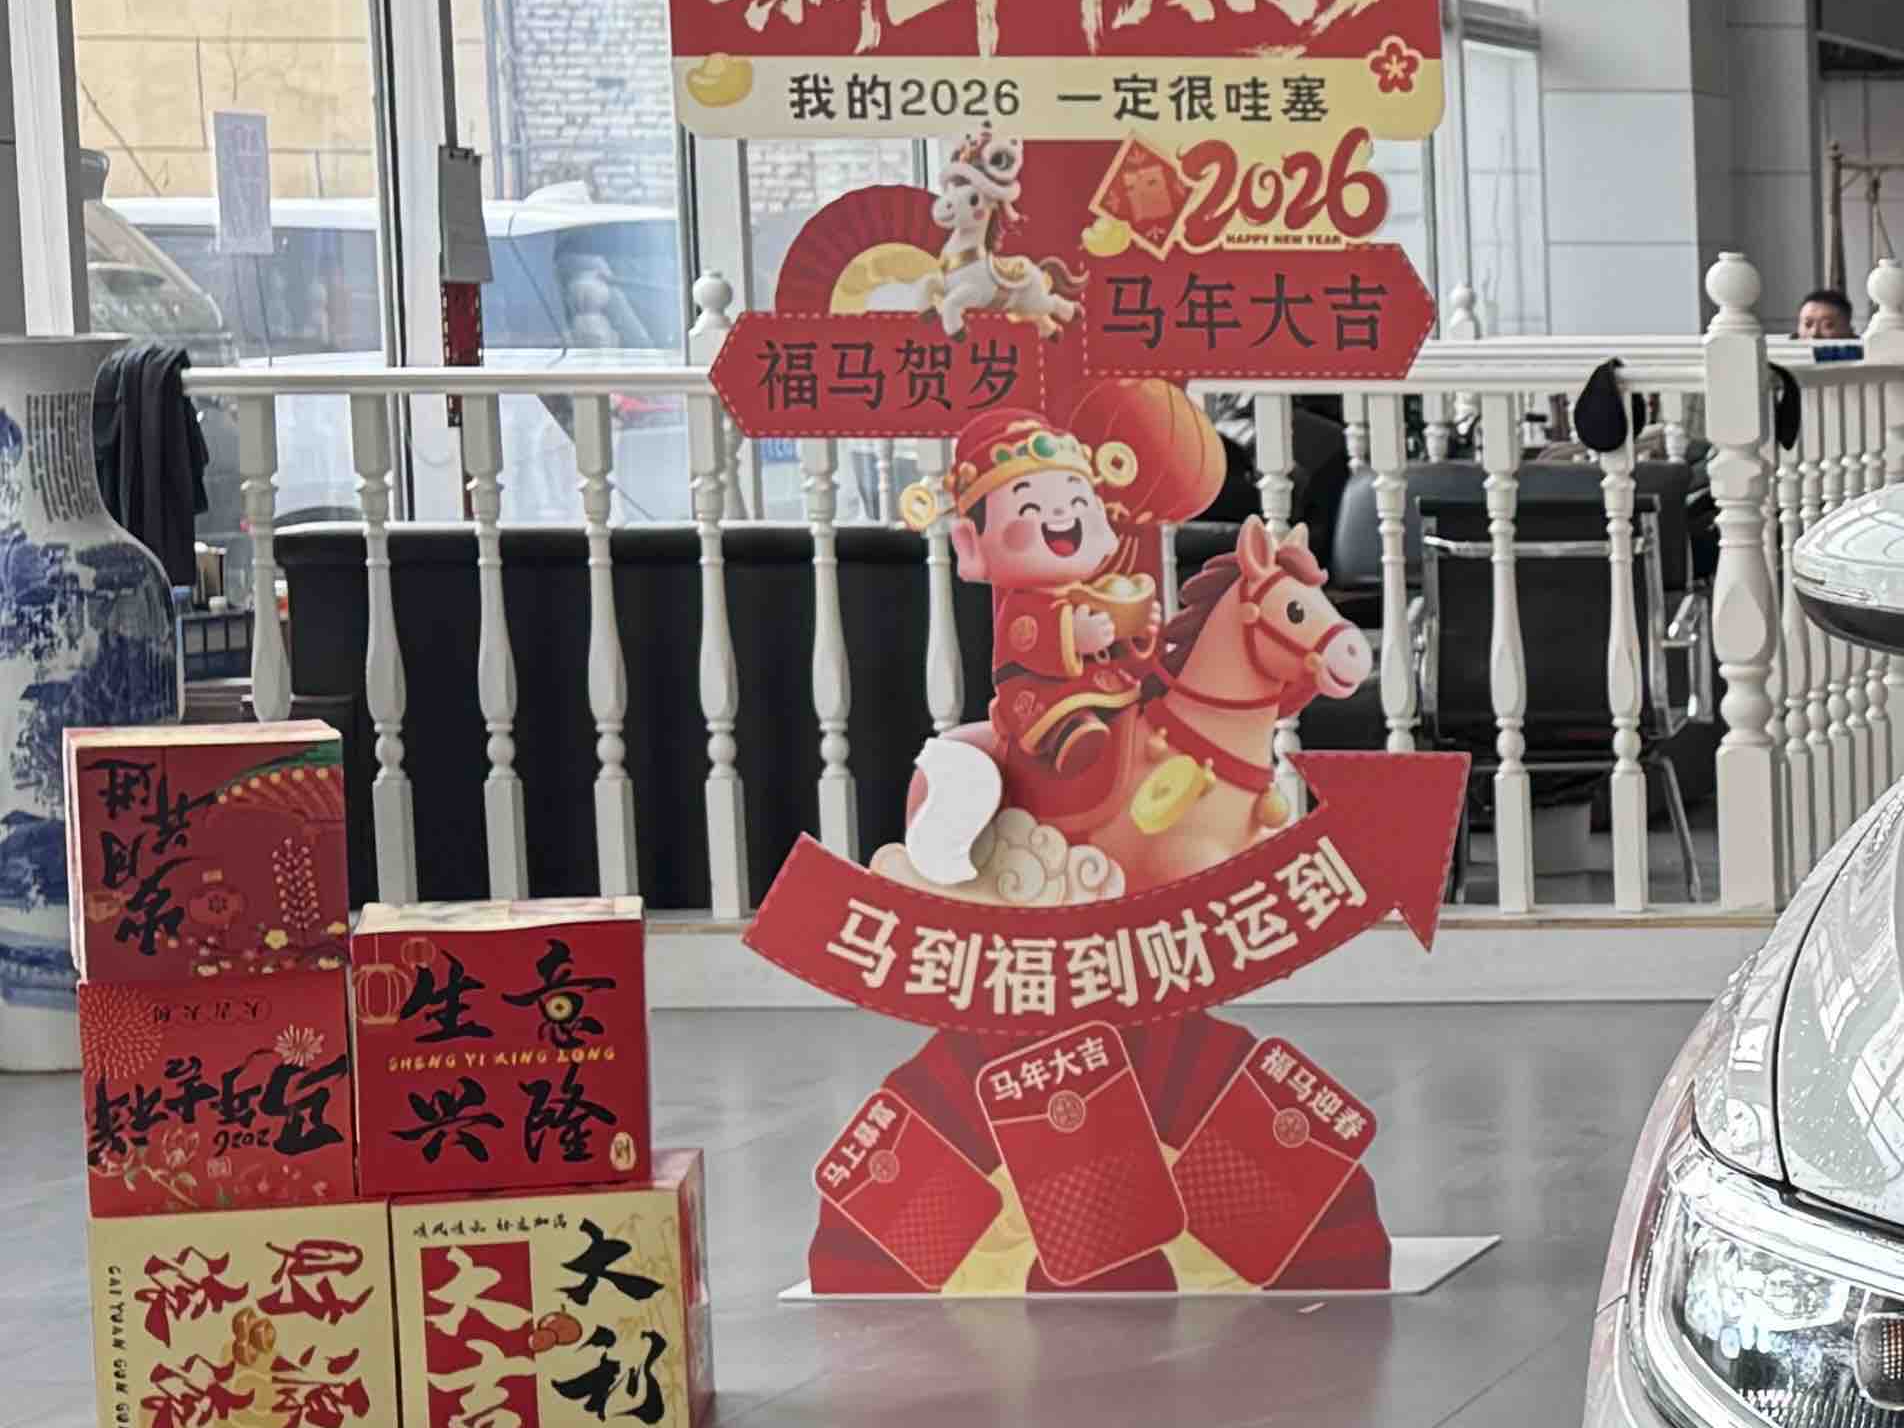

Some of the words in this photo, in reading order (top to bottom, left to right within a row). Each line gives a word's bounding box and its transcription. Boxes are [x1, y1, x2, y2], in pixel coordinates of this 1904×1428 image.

[789, 74, 1021, 121] 我的2026
[1056, 73, 1330, 122] 一定很哇塞
[1177, 126, 1389, 245] 2026
[1226, 234, 1268, 245] HAPPY
[1274, 234, 1303, 245] NEW
[1307, 234, 1343, 245] YEAR
[1101, 274, 1389, 352] 马年大吉
[756, 339, 1021, 411] 福马贺岁
[825, 838, 1367, 1018] 马到福到财运到
[400, 938, 617, 1050] 生意
[388, 1055, 456, 1071] SHENG
[464, 1053, 486, 1068] YI
[557, 1046, 617, 1063] LONG
[987, 1036, 1112, 1105] 马年大吉
[1259, 1046, 1370, 1142] 福马迎春
[212, 1128, 270, 1157] 2026
[388, 1060, 618, 1163] 兴隆
[823, 1098, 898, 1189] 马上暴富
[551, 1217, 669, 1425] 大利
[113, 1360, 128, 1395] GUN
